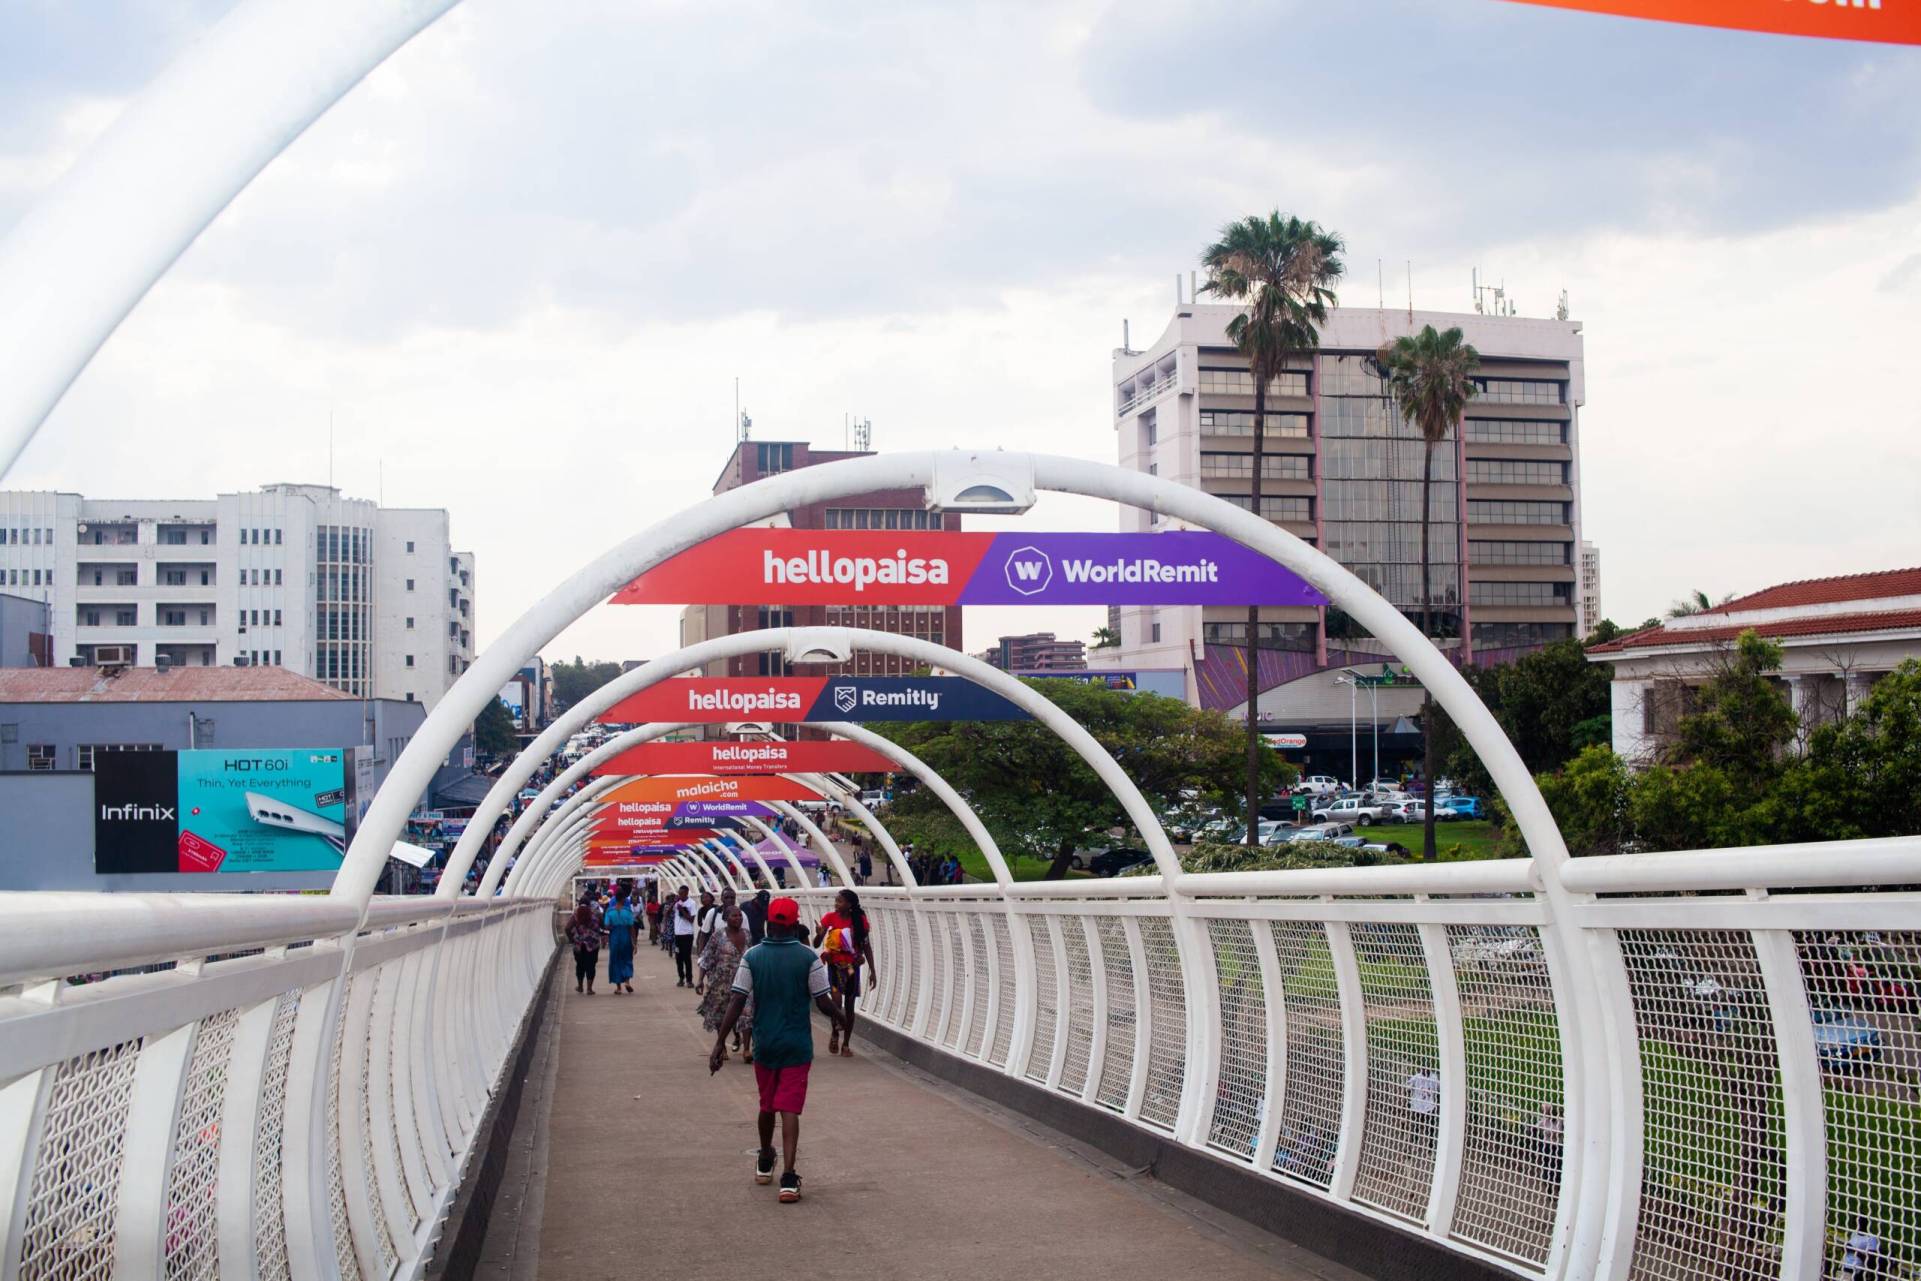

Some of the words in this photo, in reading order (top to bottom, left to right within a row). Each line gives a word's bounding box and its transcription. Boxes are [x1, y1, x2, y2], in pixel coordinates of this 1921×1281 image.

[763, 549, 949, 591] hellopaisa
[1061, 558, 1219, 583] WorldRemit
[688, 688, 801, 713] hellopaisa
[862, 689, 939, 710] Remitly
[712, 745, 788, 763] hellopaisa
[224, 759, 262, 772] HOT
[264, 759, 289, 771] 60i
[198, 778, 225, 788] Thin,
[228, 778, 247, 788] Yet
[249, 778, 312, 789] Everything
[676, 781, 738, 798] malaicha
[102, 803, 175, 821] Infinix
[619, 802, 672, 814] hellopaisa
[702, 803, 748, 811] WorldRemit
[617, 818, 662, 827] hellopaisa
[684, 817, 716, 825] Remitly
